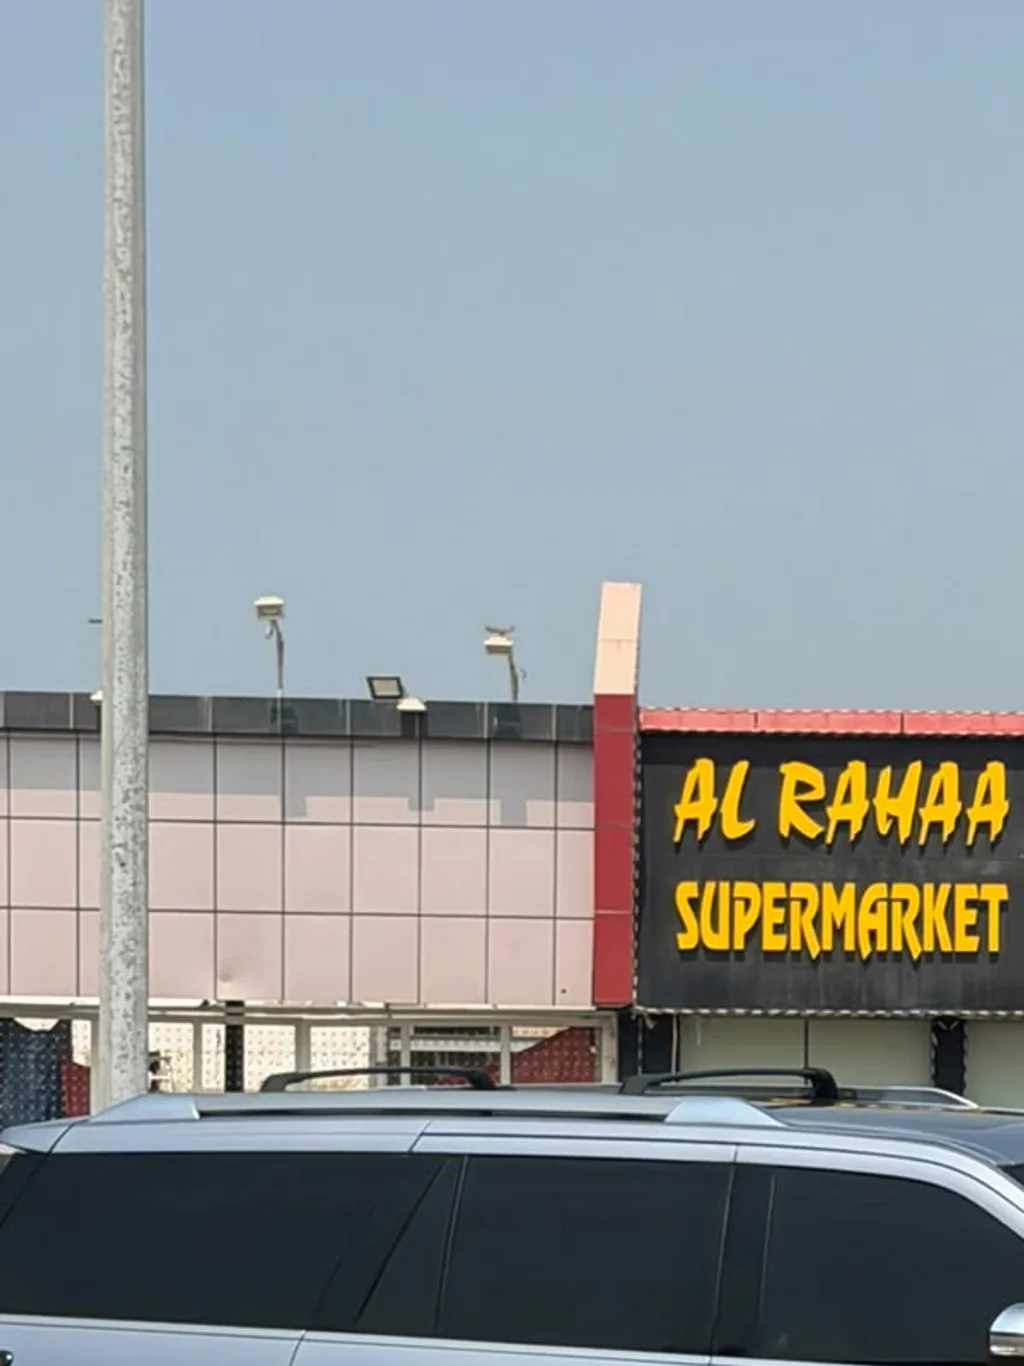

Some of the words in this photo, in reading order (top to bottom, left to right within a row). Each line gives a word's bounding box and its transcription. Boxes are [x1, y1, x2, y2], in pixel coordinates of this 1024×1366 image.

[673, 757, 756, 845] AL
[779, 758, 1010, 847] RAHAA
[674, 880, 1010, 962] SUPERMARKET
